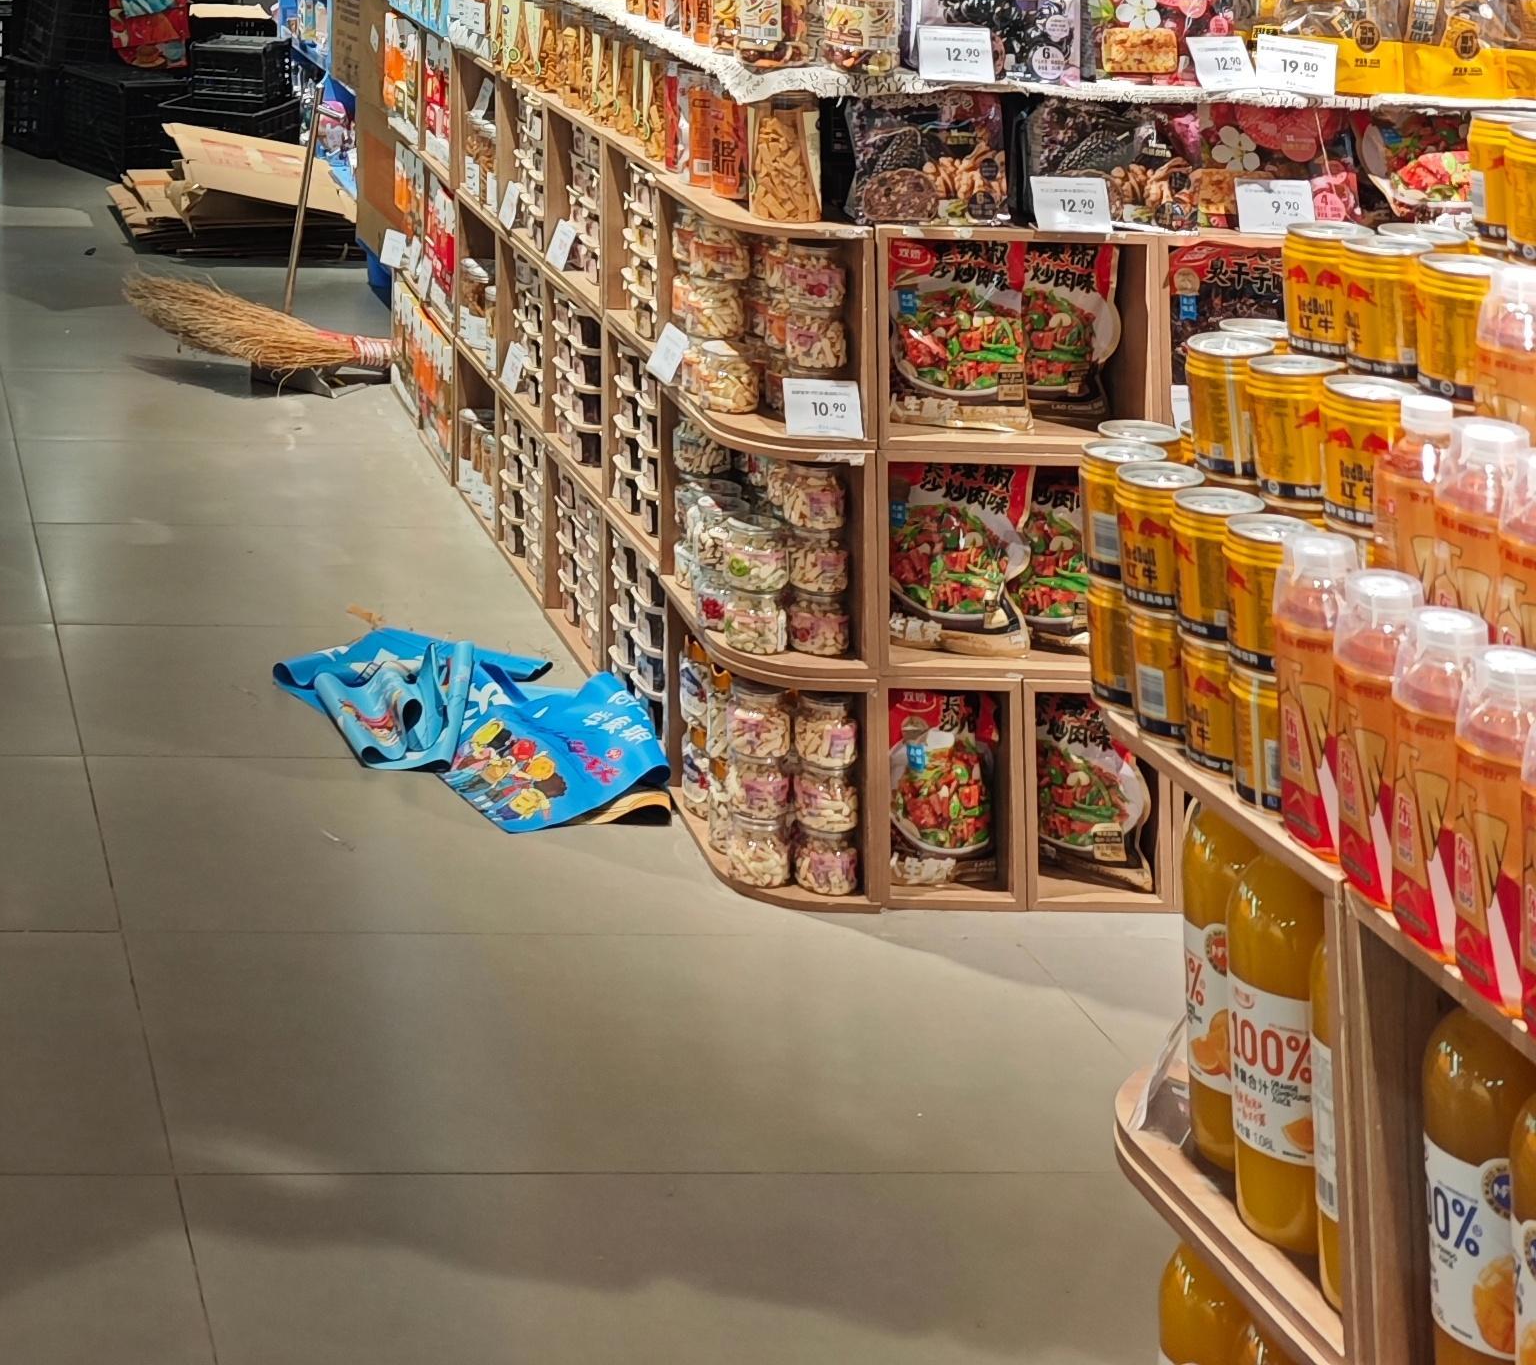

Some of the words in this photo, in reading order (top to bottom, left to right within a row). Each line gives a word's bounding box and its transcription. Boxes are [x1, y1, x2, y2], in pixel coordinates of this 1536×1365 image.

[944, 46, 980, 62] 12.90
[1280, 58, 1319, 76] 19.80
[1060, 197, 1096, 214] 12.90
[811, 401, 848, 418] 10.90
[1231, 1011, 1313, 1086] 100%
